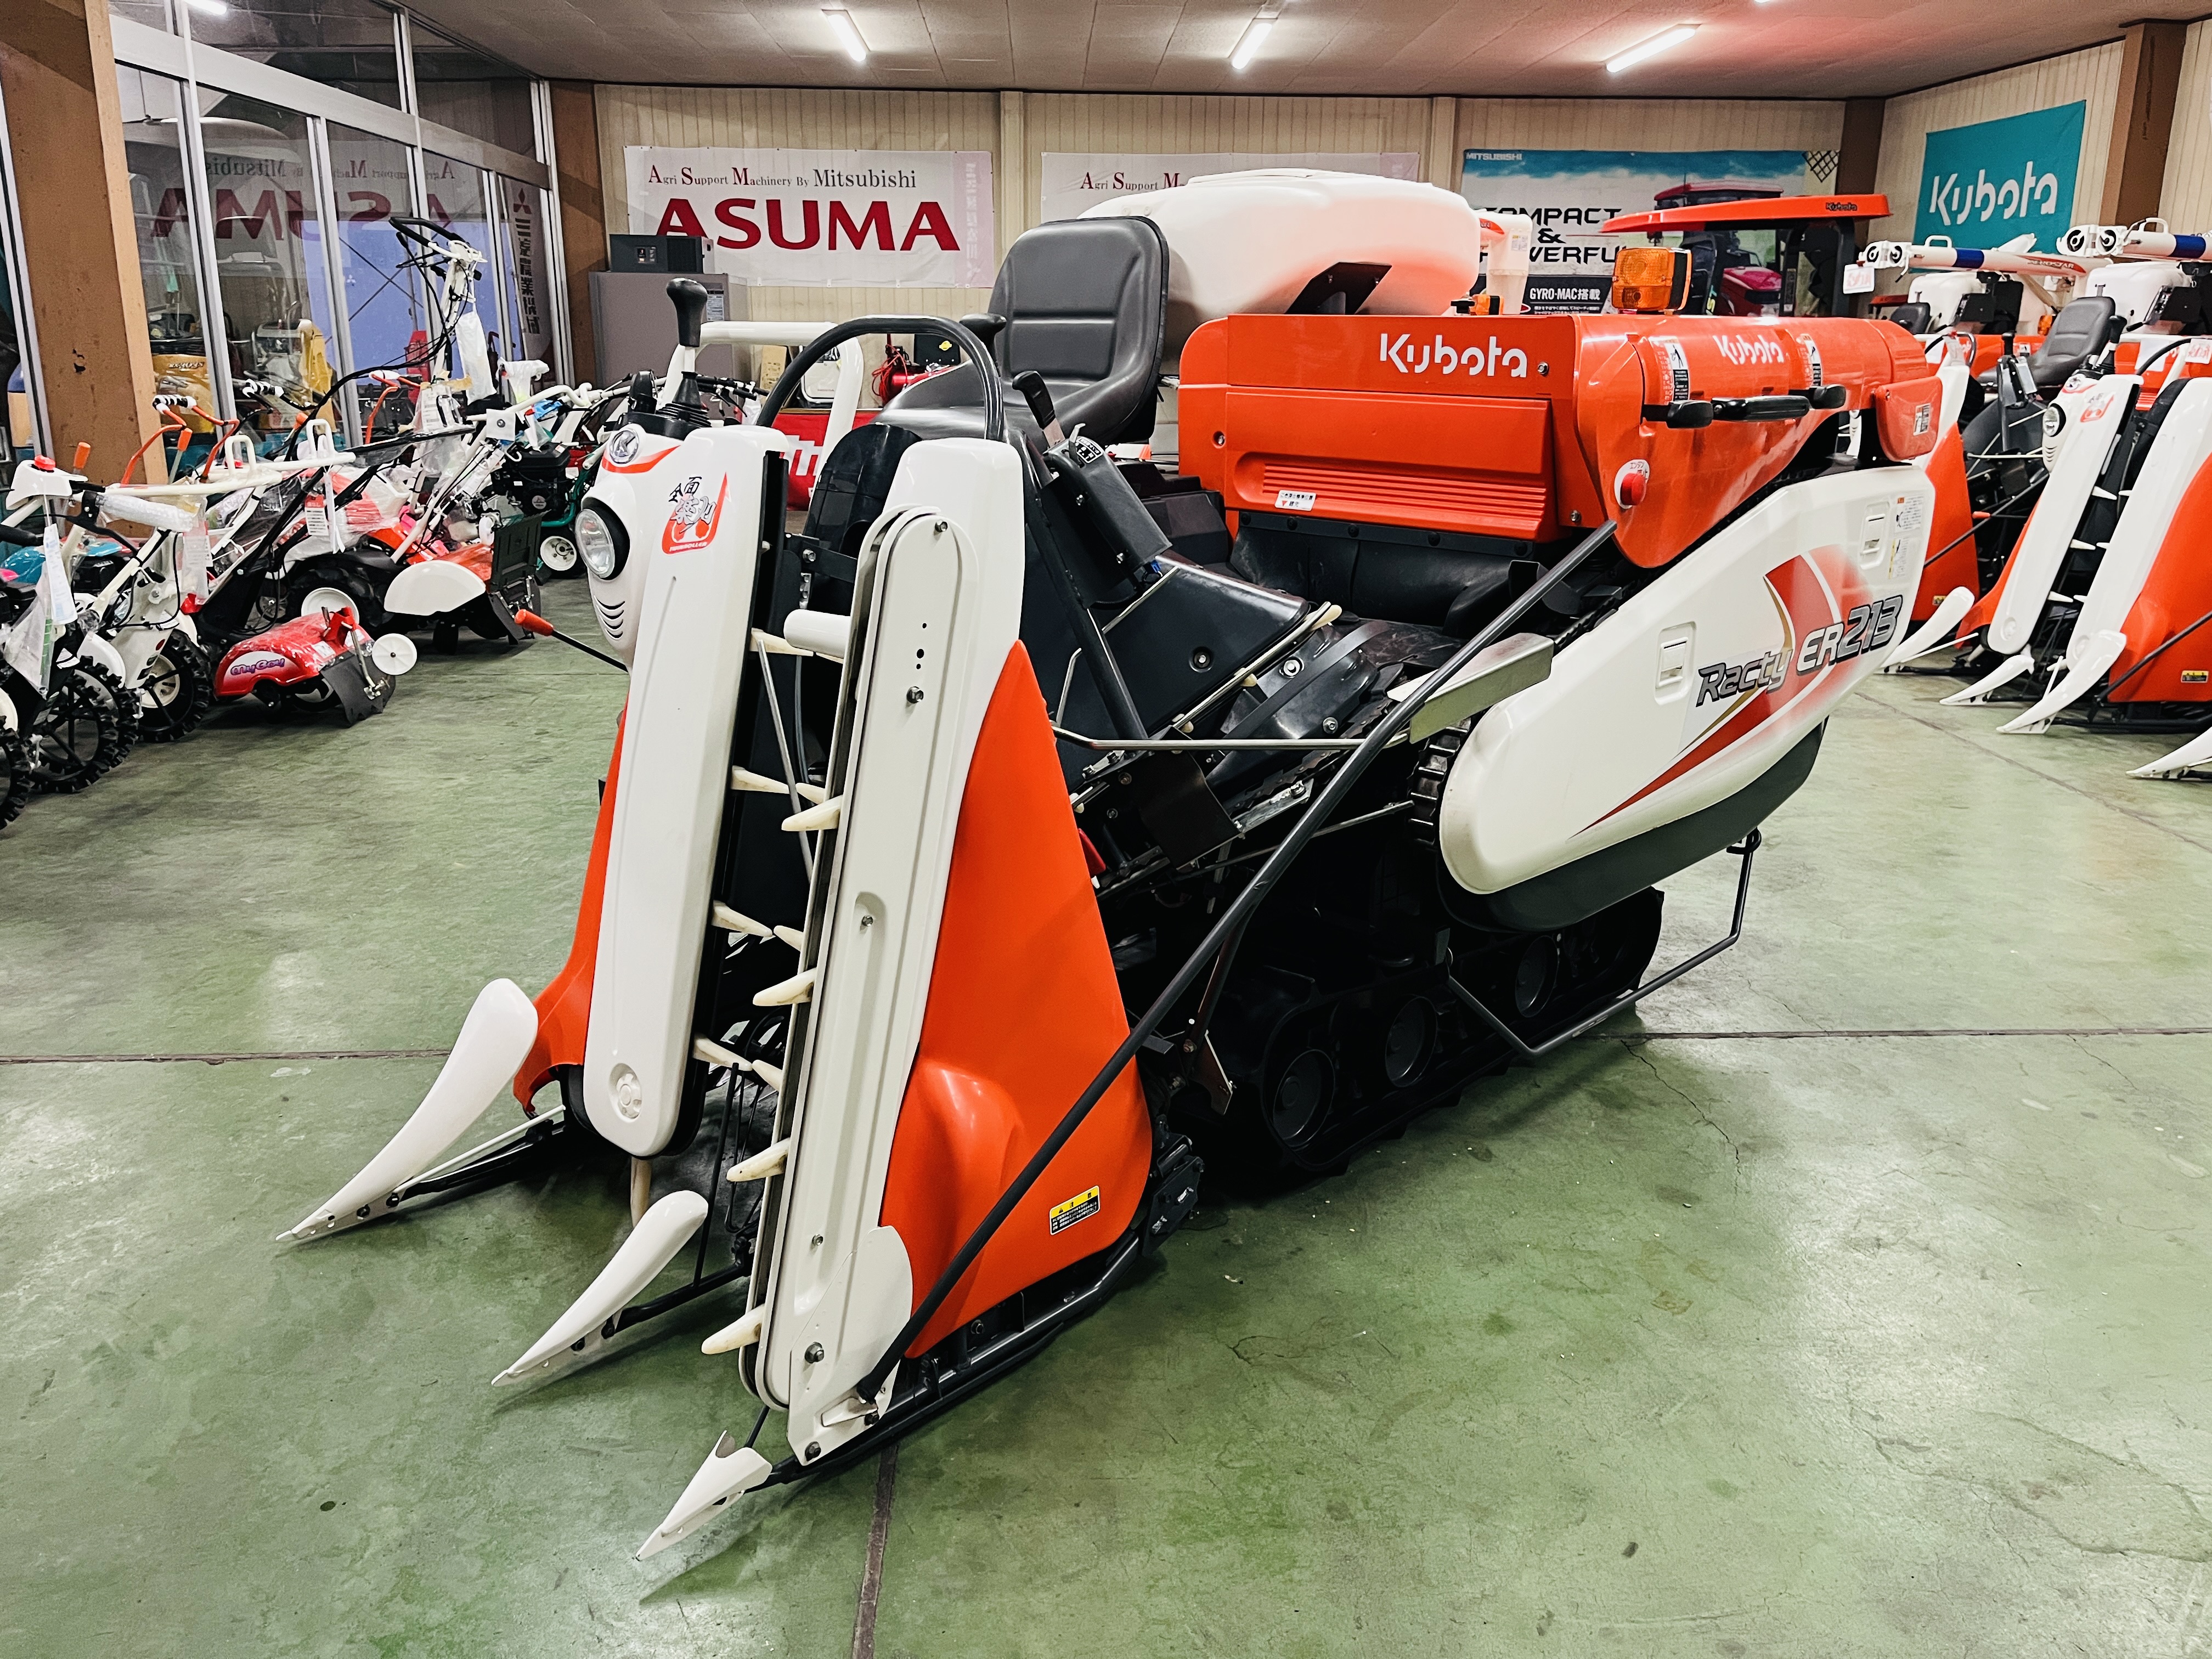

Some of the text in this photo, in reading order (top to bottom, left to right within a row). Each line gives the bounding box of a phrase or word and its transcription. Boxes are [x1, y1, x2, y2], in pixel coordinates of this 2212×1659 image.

[1466, 153, 1522, 161] MITSUBISHI
[648, 165, 916, 188] Agri Support Machinery By Mitsubishi
[1080, 172, 1108, 190] Agri
[1113, 172, 1159, 191] Support
[1929, 160, 2058, 225] Kubota
[1477, 207, 1622, 226] MPACT
[1826, 202, 1858, 211] Kubota
[655, 197, 961, 251] ASUMA
[1537, 228, 1566, 244] &
[1380, 332, 1527, 378] Kubota
[1712, 334, 1785, 365] Kubota
[1696, 594, 1904, 707] Racty ER213
